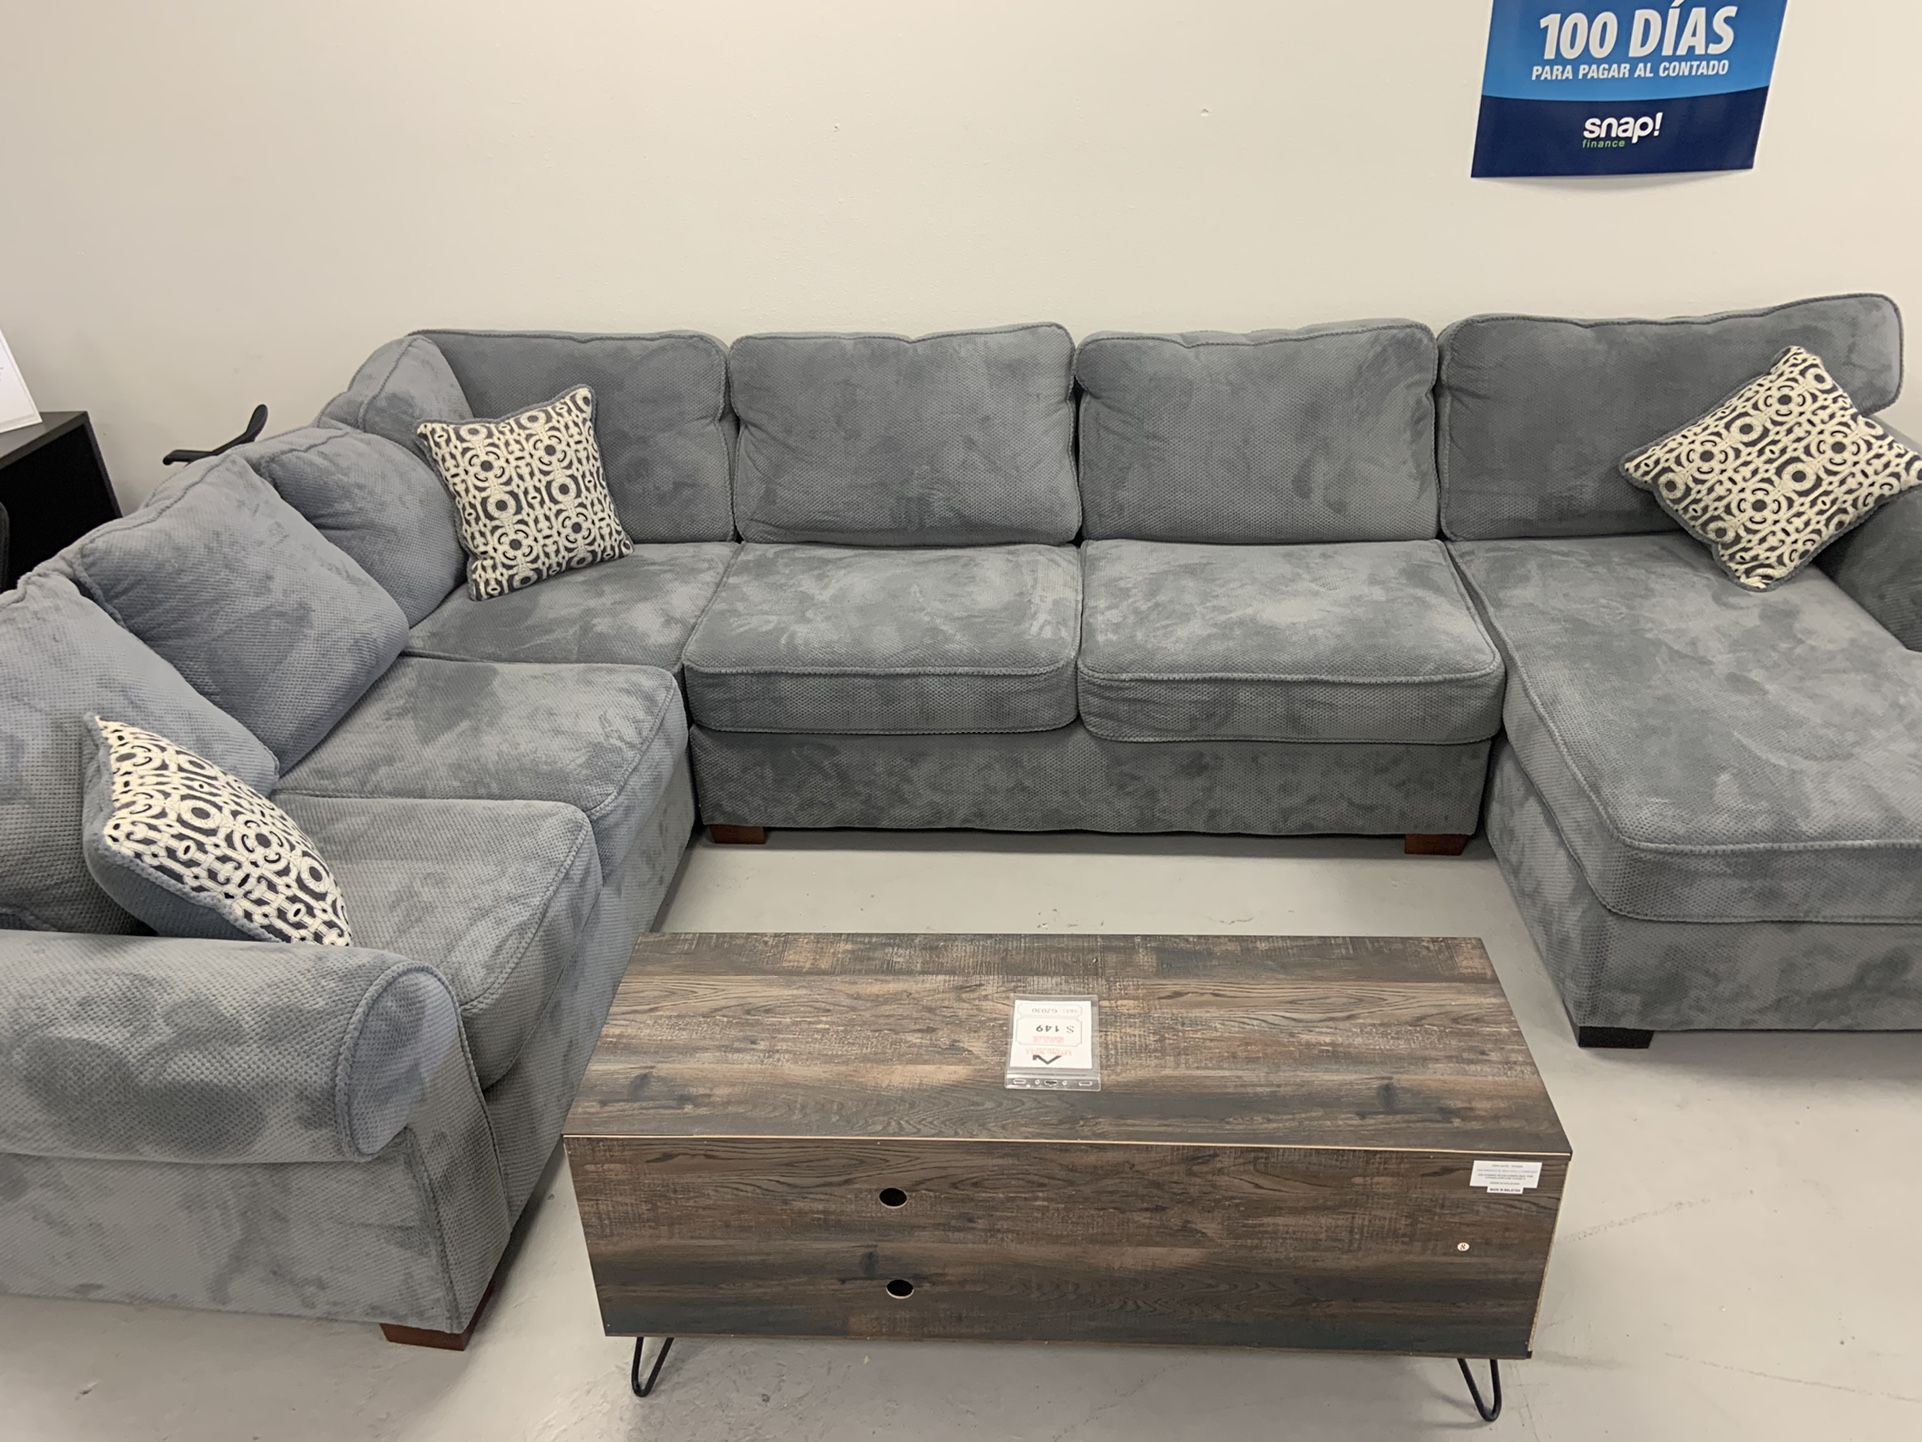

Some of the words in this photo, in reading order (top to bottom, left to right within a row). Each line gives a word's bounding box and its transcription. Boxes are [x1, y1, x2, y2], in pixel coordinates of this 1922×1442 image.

[1539, 11, 1618, 60] 100
[1628, 0, 1738, 58] DÍAS
[1531, 65, 1573, 81] PARA
[1578, 63, 1630, 80] PAGAR
[1634, 62, 1654, 77] AL
[1659, 60, 1729, 77] CONTADO
[1582, 111, 1664, 144] snap!
[1582, 139, 1626, 149] finance
